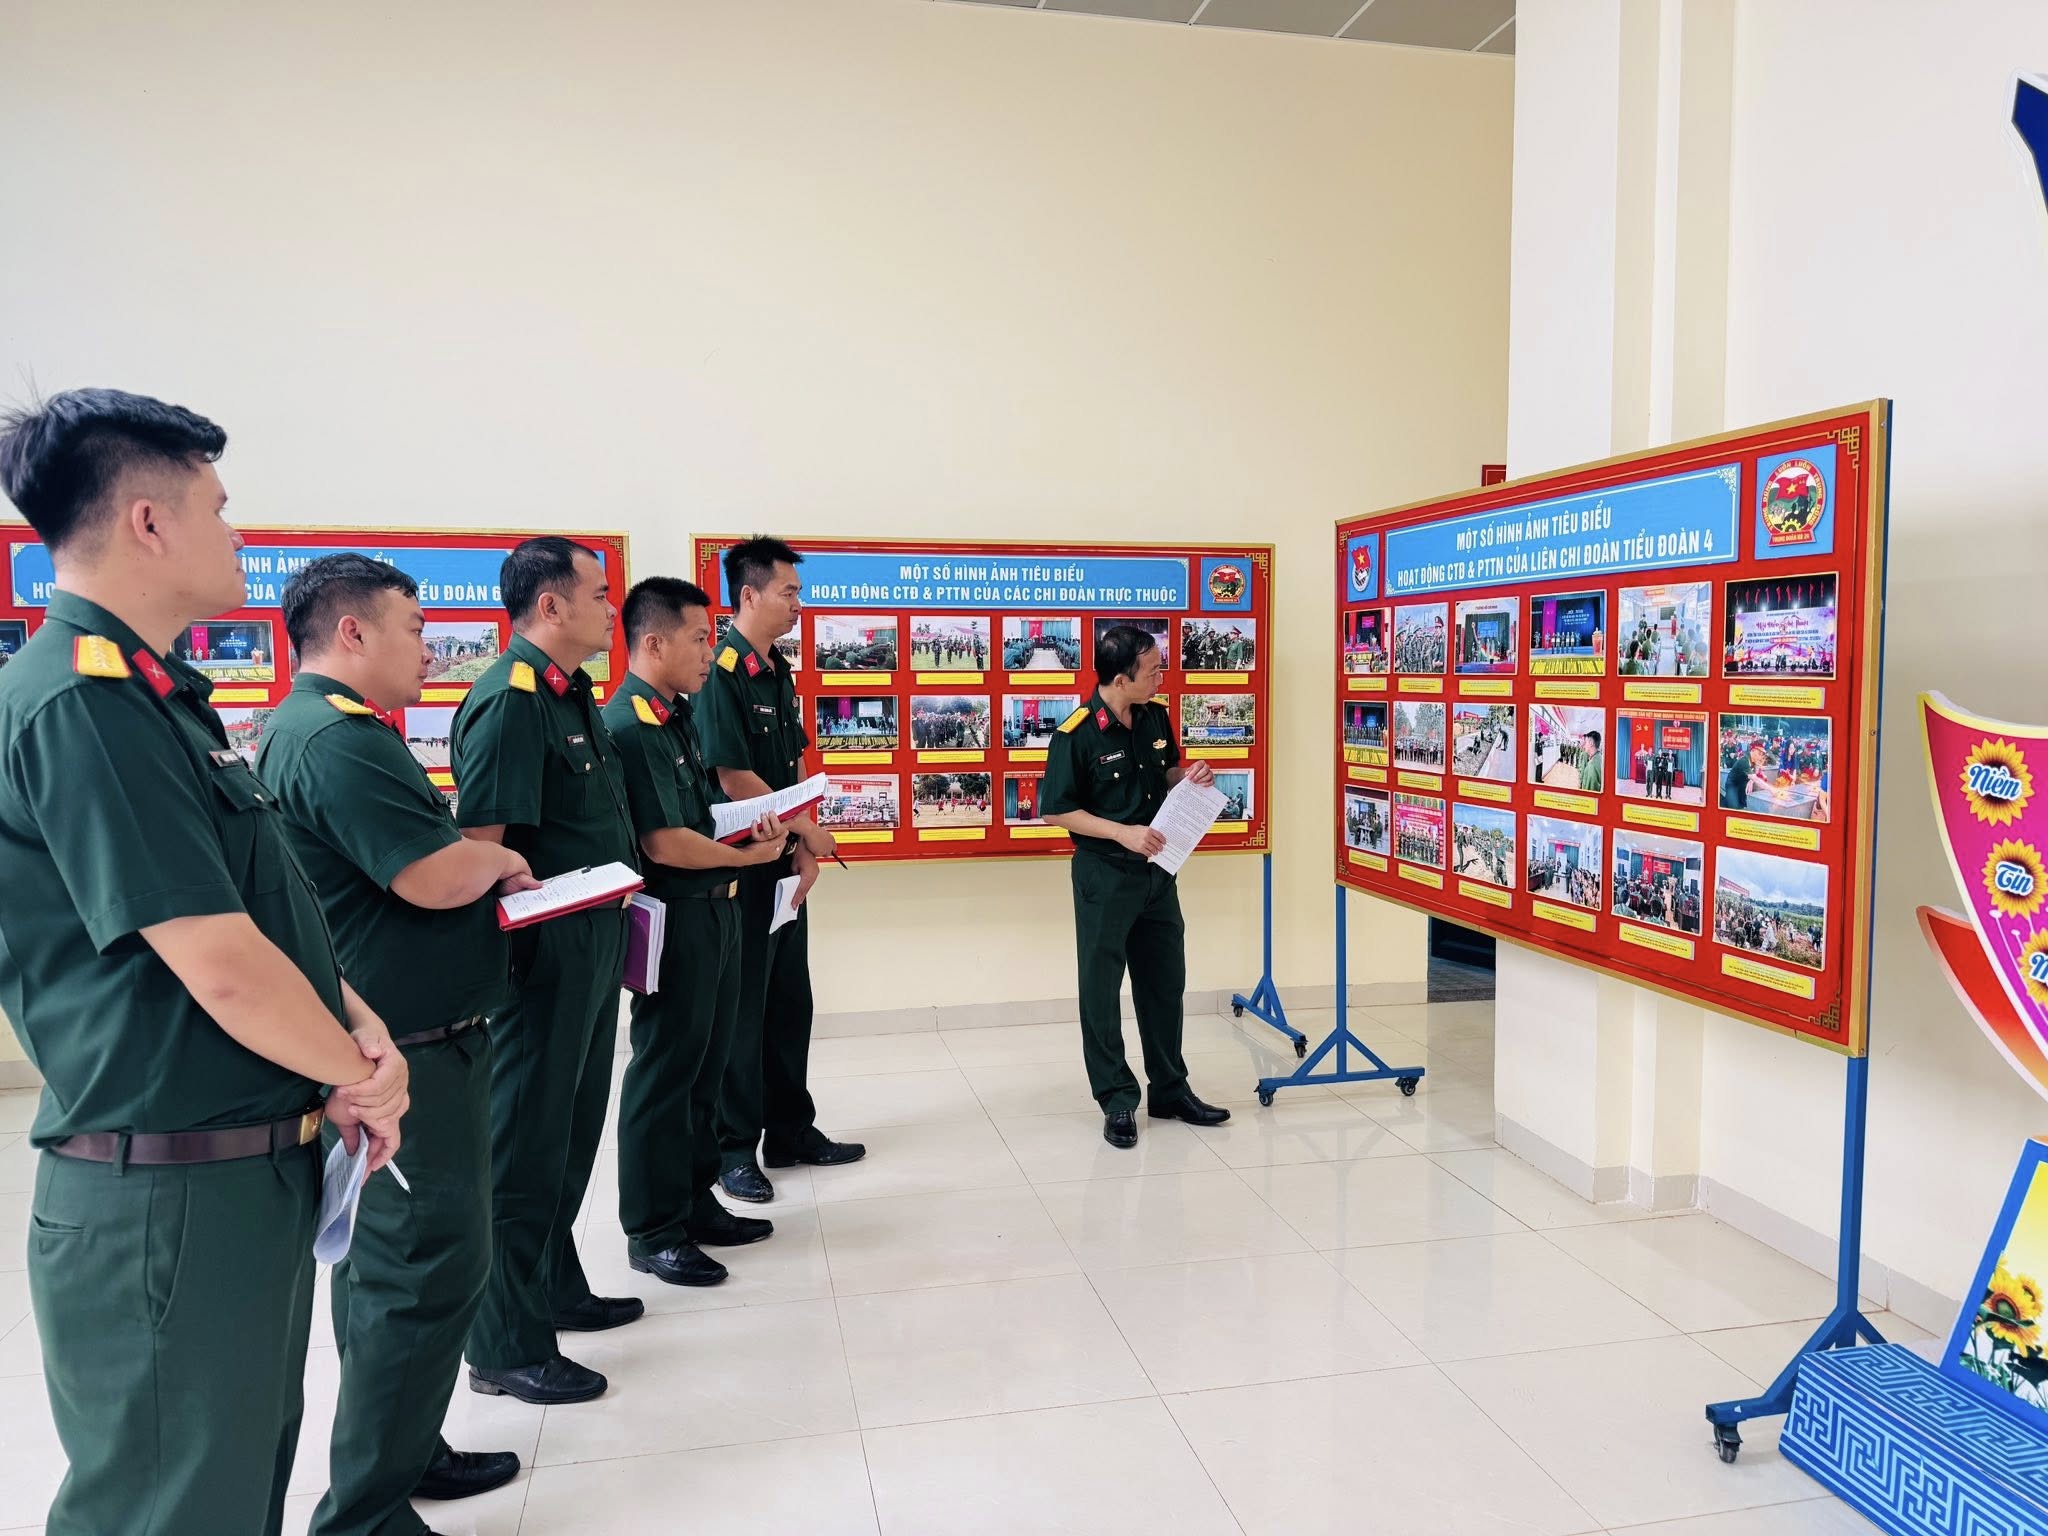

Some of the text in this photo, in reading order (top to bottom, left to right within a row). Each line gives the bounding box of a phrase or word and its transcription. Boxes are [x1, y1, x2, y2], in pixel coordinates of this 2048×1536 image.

[1456, 500, 1612, 553] MỘT SỐ HÌNH ẢNH TIÊU BIỂU
[241, 553, 272, 574] ÌNH
[1398, 568, 1418, 590] HOẠT
[1420, 562, 1445, 588] ĐỘNG
[1467, 560, 1474, 579] &
[1478, 556, 1504, 578] PTTN
[1506, 546, 1528, 574] CỦA
[1531, 546, 1557, 572] LIÊN
[1560, 545, 1581, 568] CHI
[1584, 538, 1620, 566] ĐOÀN
[1623, 528, 1654, 561] TIỂU
[1658, 528, 1700, 557] ĐOÀN
[1704, 528, 1714, 552] 4
[900, 562, 1084, 584] MỘT SỐ HÌNH ẢNH TIÊU BIỂU
[444, 582, 488, 600] ĐOÀN
[812, 582, 1177, 604] HOẠT ĐỘNG CTĐ & PTTN CỦA CÁC CHI ĐOÀN TRỰC THUỘC
[1969, 765, 2020, 799] Niềm
[1997, 863, 2031, 893] Tin
